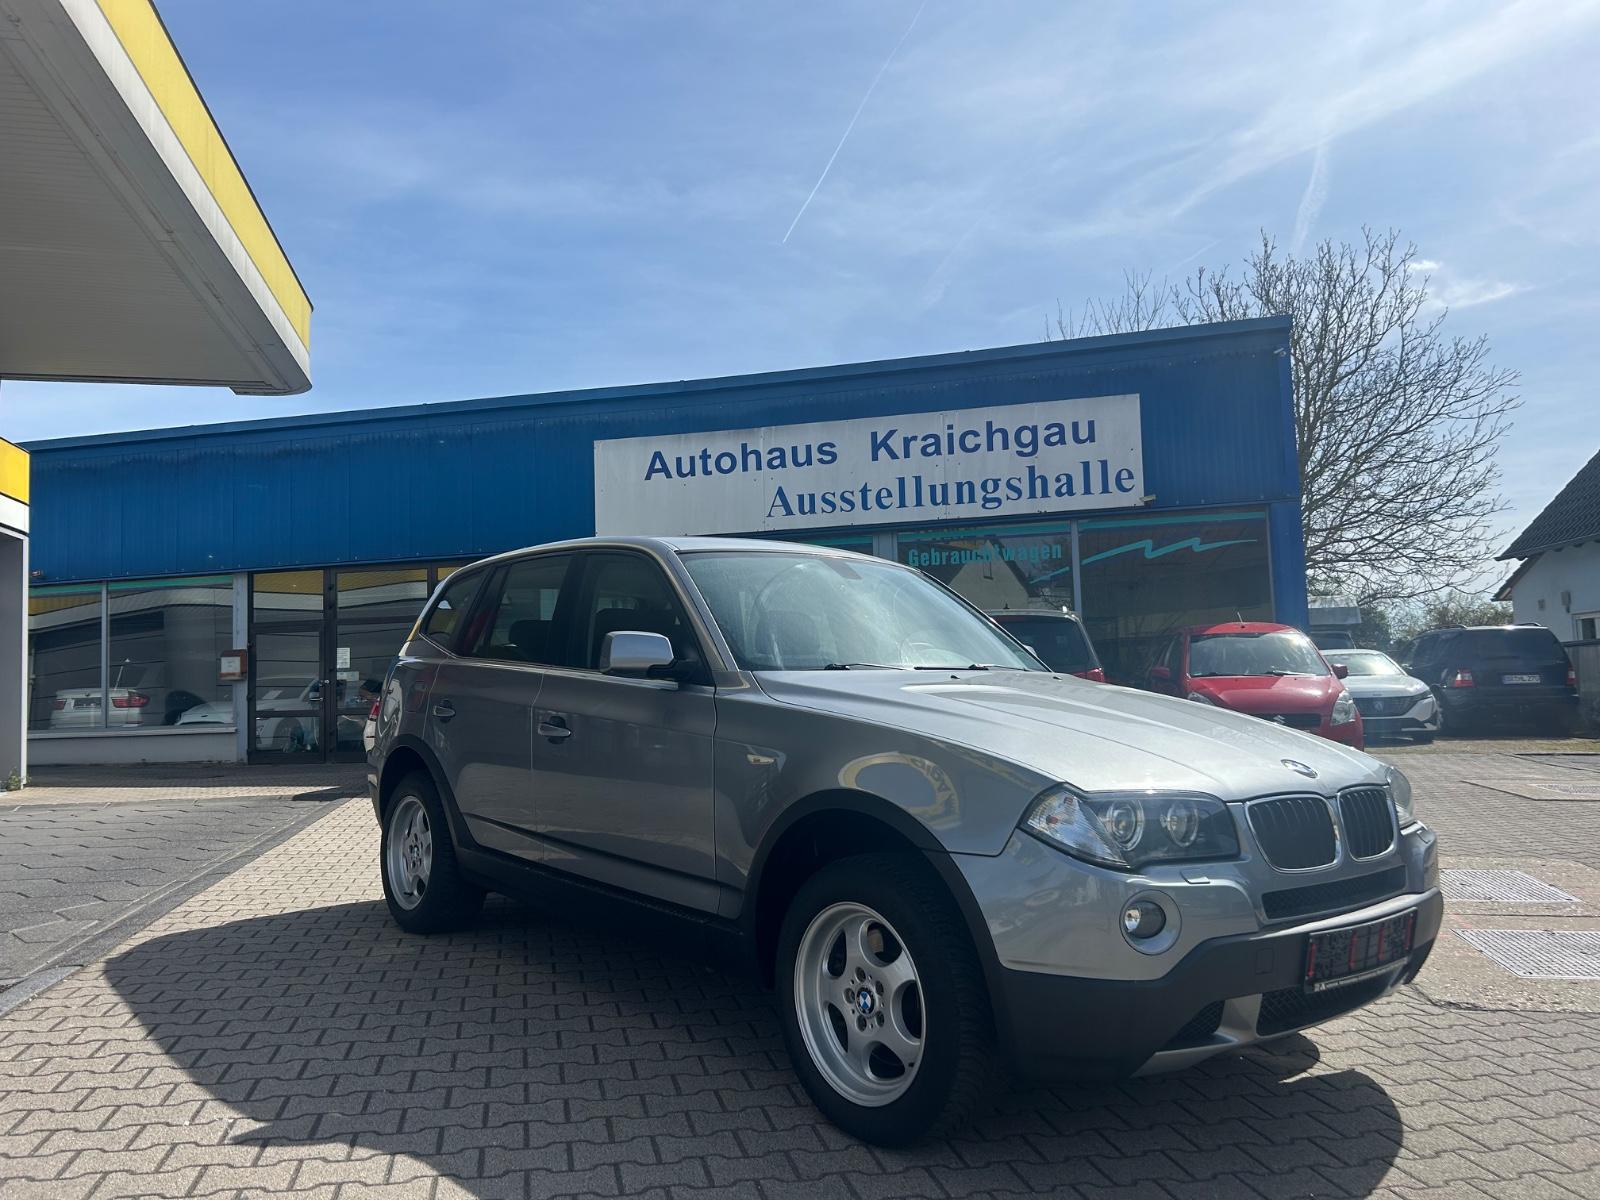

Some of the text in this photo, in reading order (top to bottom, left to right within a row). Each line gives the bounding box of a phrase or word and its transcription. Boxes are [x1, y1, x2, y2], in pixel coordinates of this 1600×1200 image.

[644, 419, 1096, 481] Autohaus Kraichgau
[766, 459, 1136, 518] Ausstellungshalle
